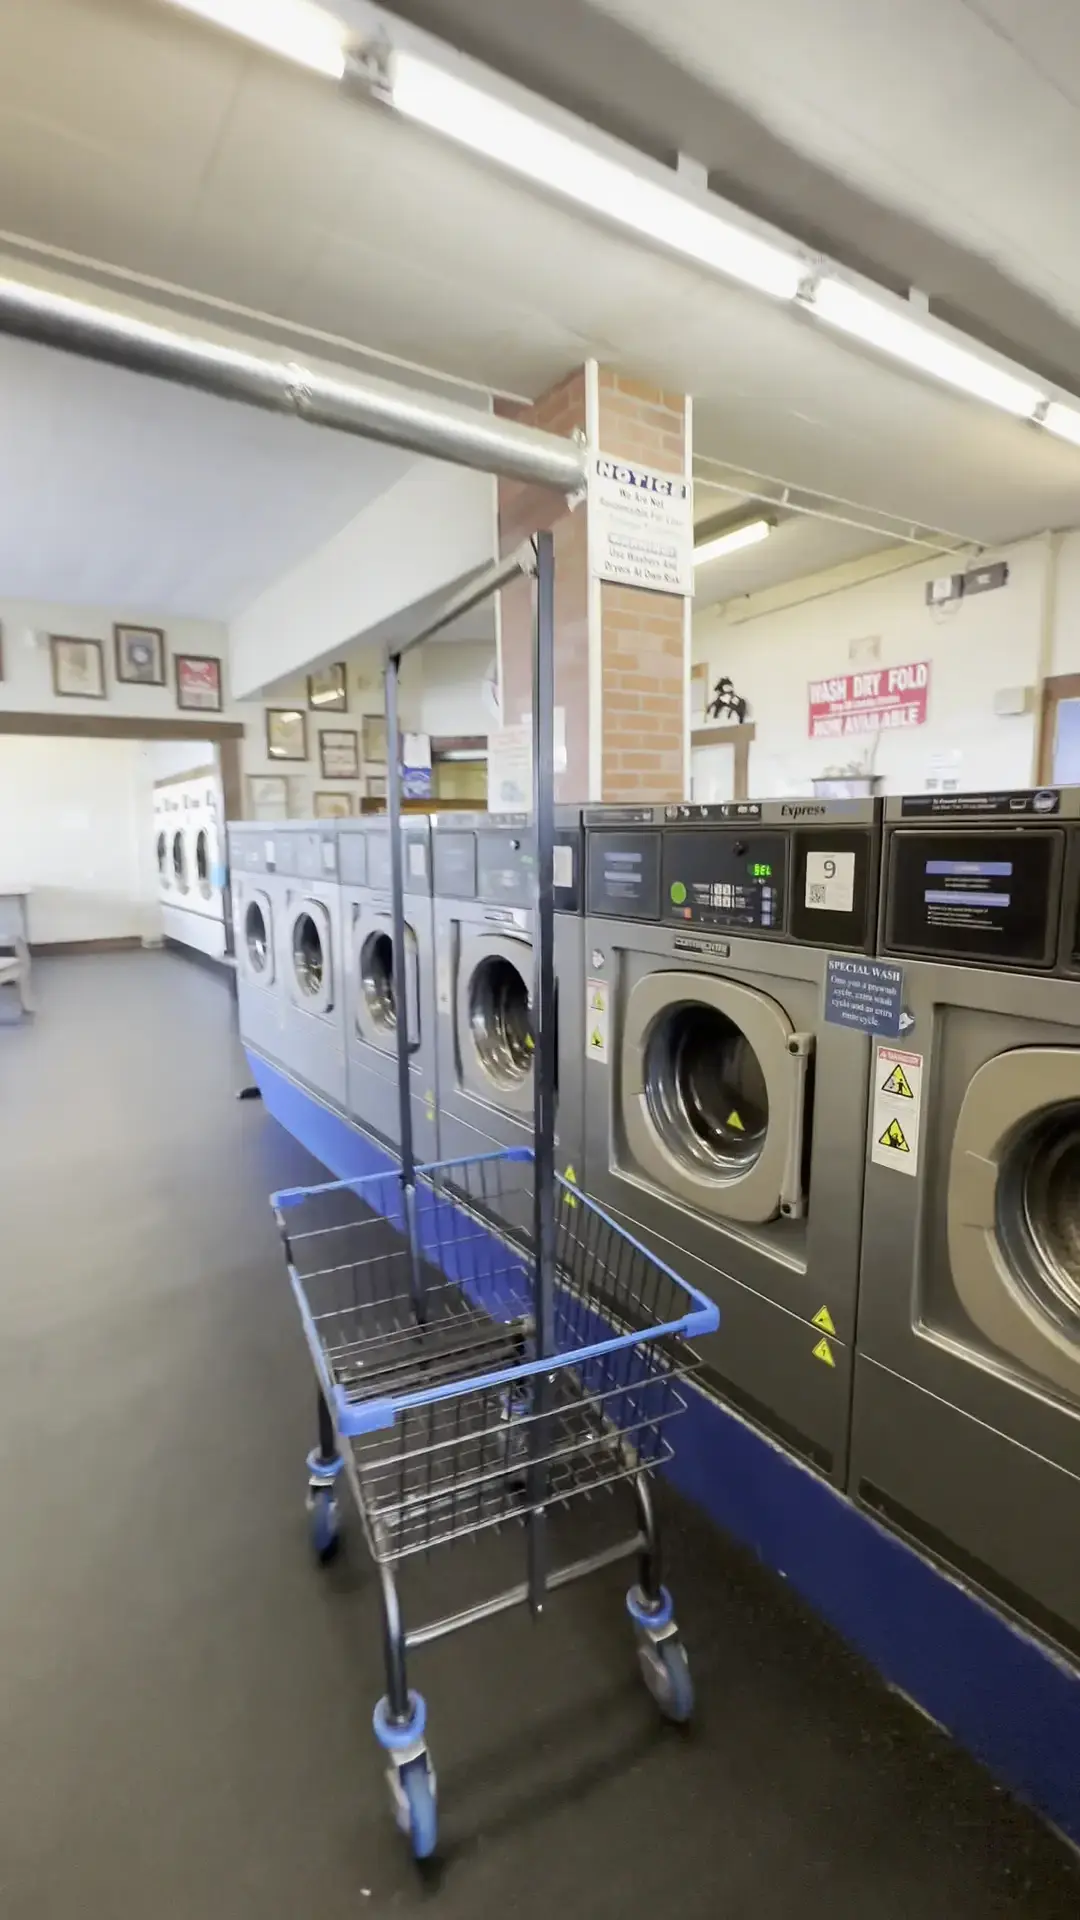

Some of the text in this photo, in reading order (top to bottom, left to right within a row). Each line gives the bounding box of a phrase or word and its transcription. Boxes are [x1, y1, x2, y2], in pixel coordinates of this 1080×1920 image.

[597, 459, 686, 499] NOTICE
[619, 488, 665, 509] We Are Not
[810, 678, 847, 705] WASH
[853, 672, 882, 699] DRY
[888, 663, 927, 695] FOLD
[813, 705, 919, 737] NOW AVAILABLE
[781, 805, 827, 819] Express
[823, 860, 837, 879] 9
[828, 960, 900, 982] SPECIAL WASH
[851, 1003, 864, 1012] and
[874, 1008, 893, 1018] extra
